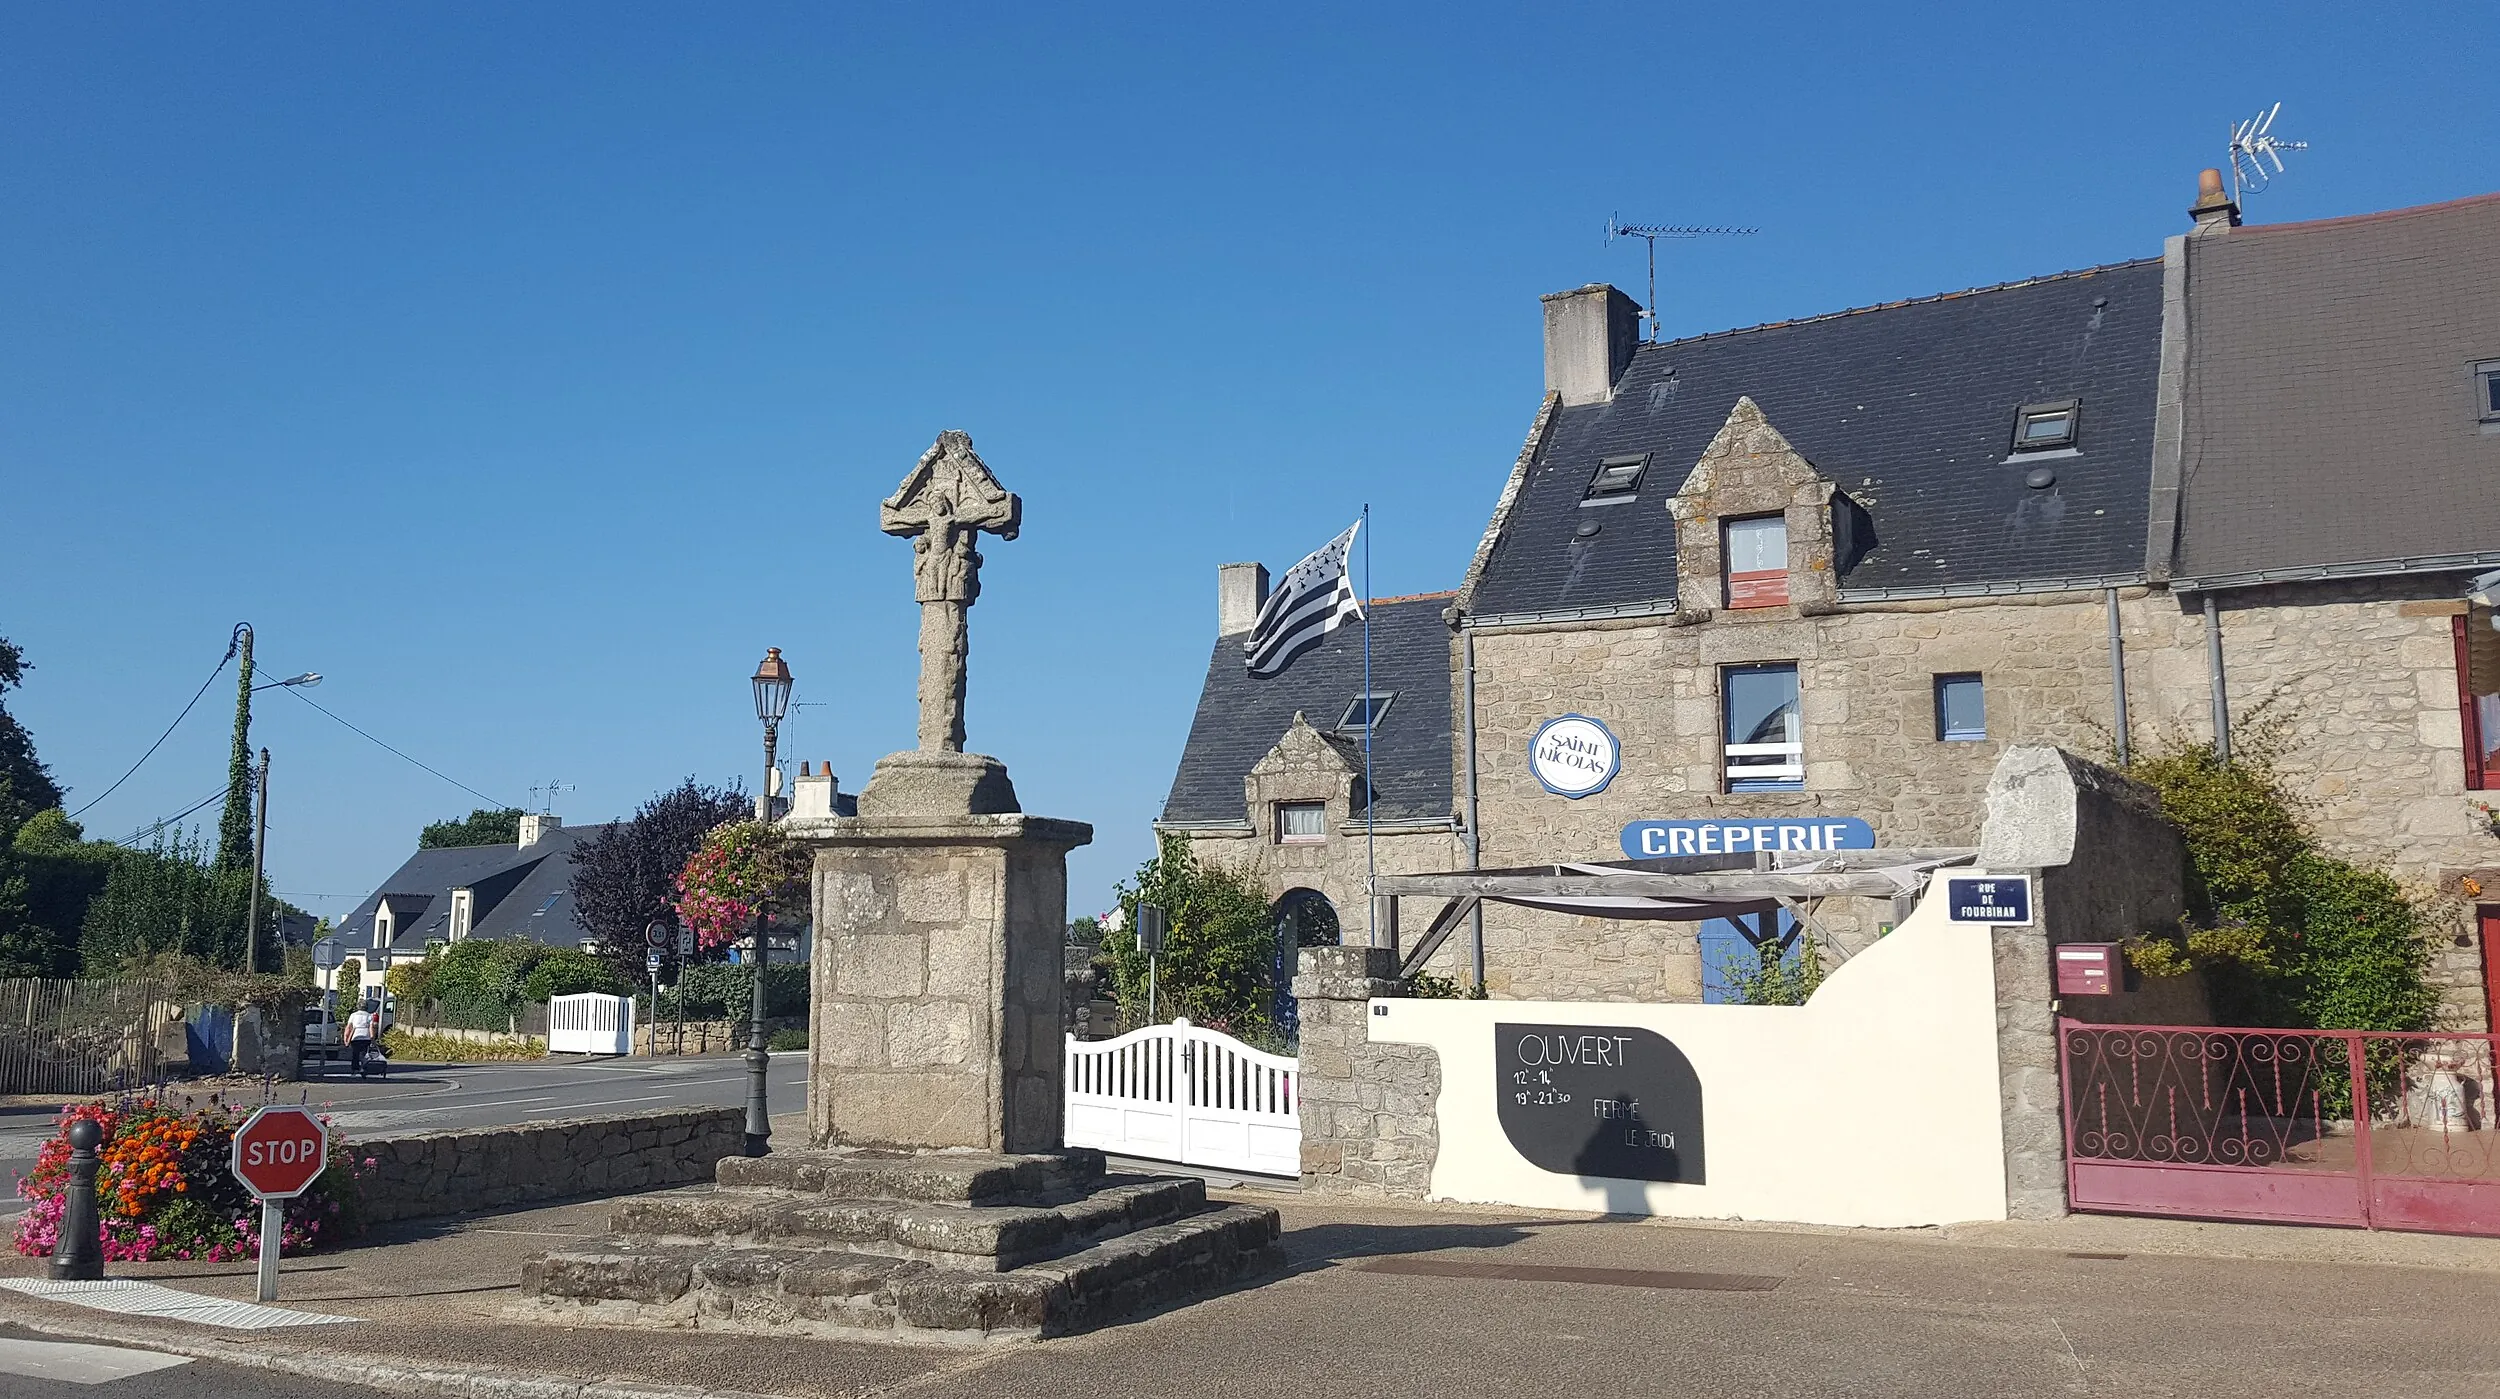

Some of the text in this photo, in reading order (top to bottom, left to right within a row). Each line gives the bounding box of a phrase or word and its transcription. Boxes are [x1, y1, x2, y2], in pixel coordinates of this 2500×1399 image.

[1640, 823, 1848, 855] CRÊPERIE
[1978, 883, 1996, 893] RUE
[1981, 895, 1994, 905] DE
[1961, 906, 2016, 918] FOURBIHAN
[2100, 984, 2107, 992] 3
[1518, 1034, 1632, 1067] OUVERT
[1594, 1098, 1641, 1121] FERMÉ
[1625, 1129, 1639, 1147] LE
[247, 1139, 316, 1166] STOP
